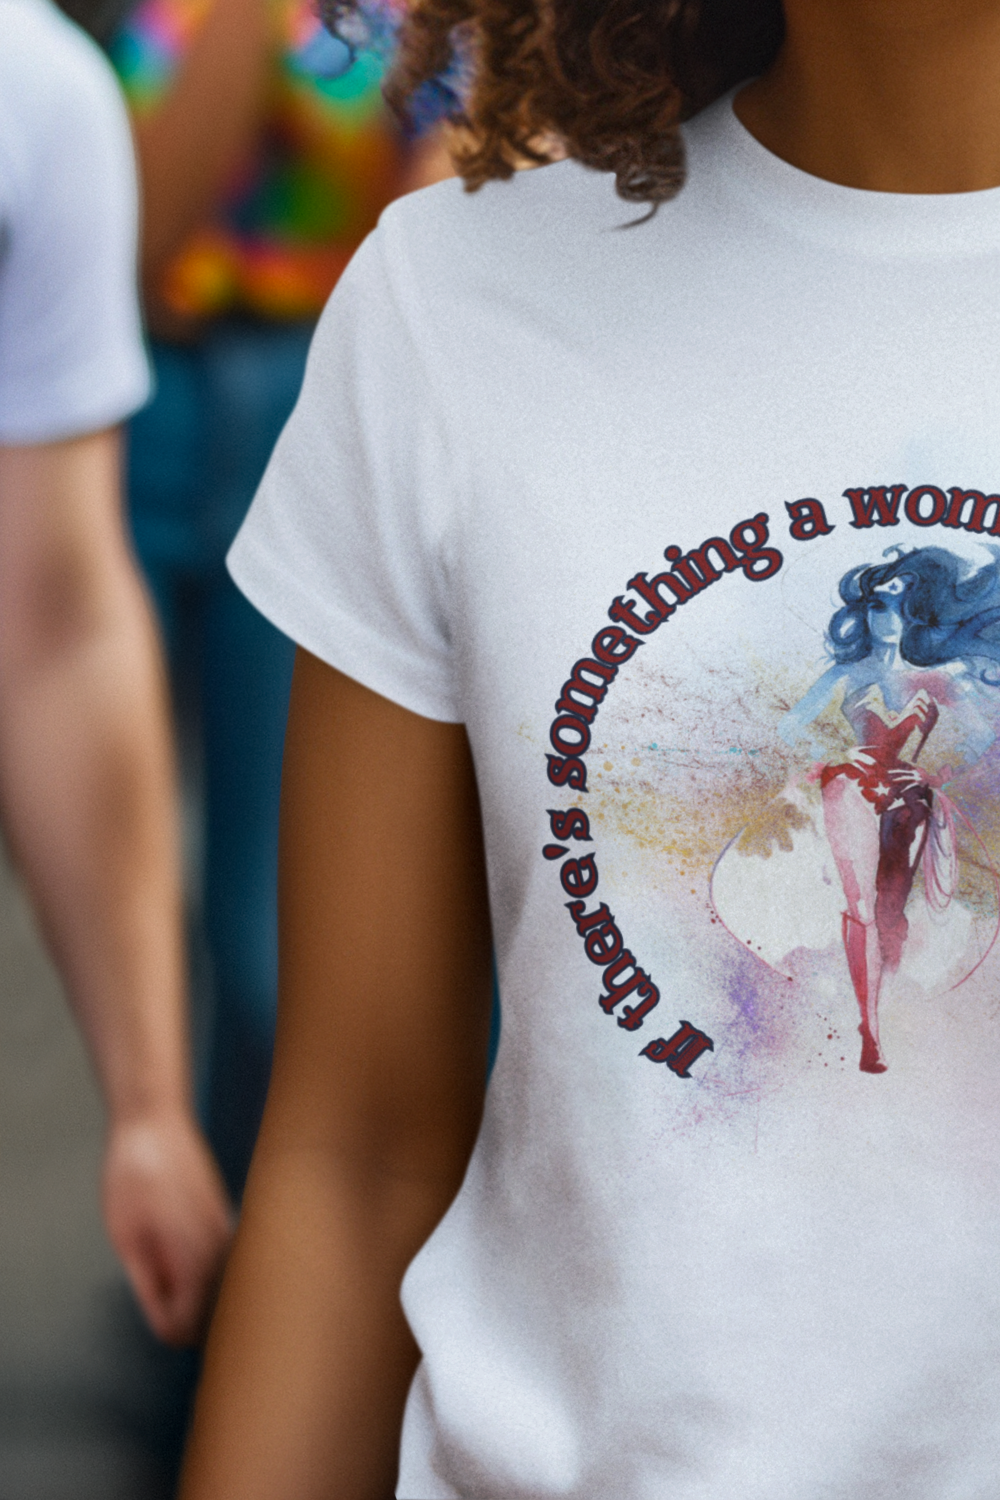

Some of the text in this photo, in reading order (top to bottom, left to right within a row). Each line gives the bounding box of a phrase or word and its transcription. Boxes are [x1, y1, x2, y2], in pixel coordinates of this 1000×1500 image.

[784, 496, 835, 541] a
[544, 512, 783, 792] something
[542, 807, 660, 1031] there's
[638, 1020, 714, 1078] If
